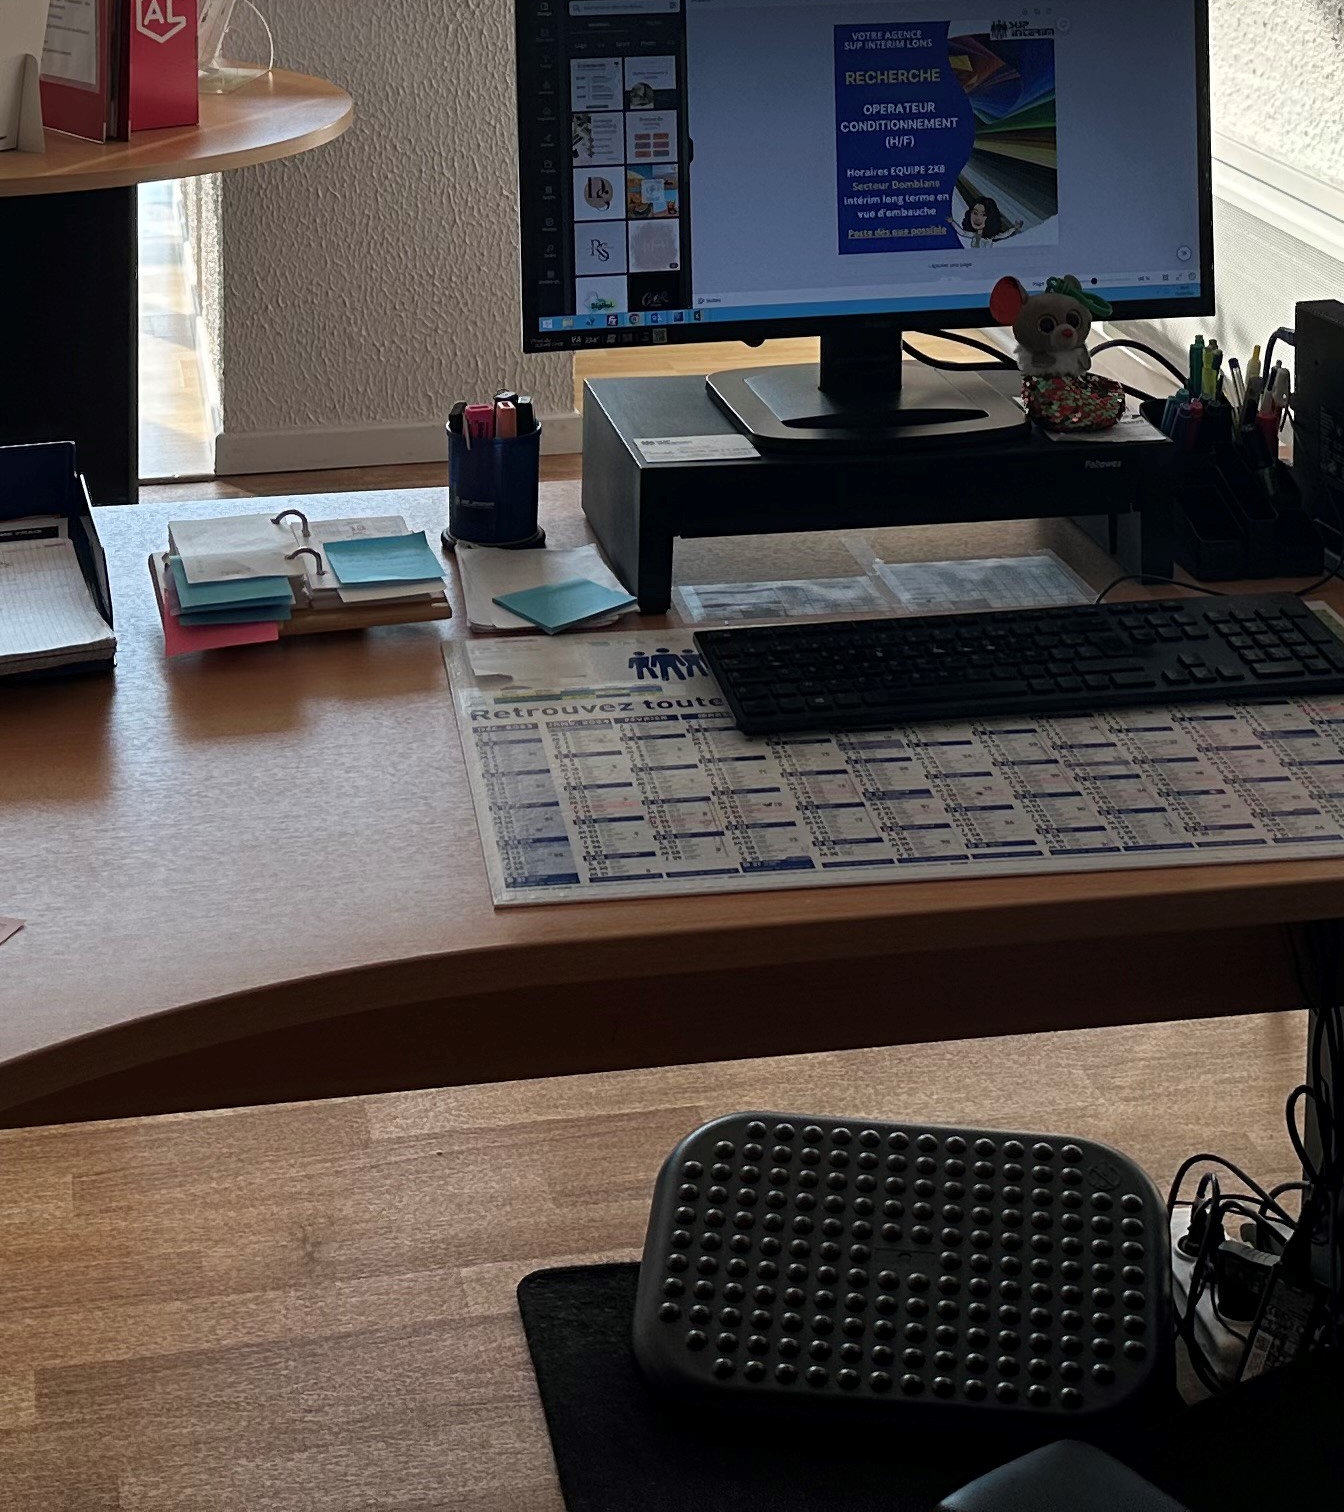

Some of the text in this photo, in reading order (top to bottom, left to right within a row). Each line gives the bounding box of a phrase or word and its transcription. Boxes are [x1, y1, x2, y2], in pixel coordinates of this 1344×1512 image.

[852, 30, 922, 41] VOTRE AGENCE
[844, 41, 863, 50] SUP
[845, 69, 941, 85] RECHERCHE
[863, 103, 936, 114] OPERATEUR
[840, 118, 958, 133] CONDITIONNEMENT
[885, 135, 915, 148] (H/F)
[847, 167, 889, 177] Horaires
[890, 166, 925, 177] EQUIPE
[883, 194, 904, 207] long
[937, 193, 949, 202] en
[470, 696, 724, 722] Retrouvez toute
